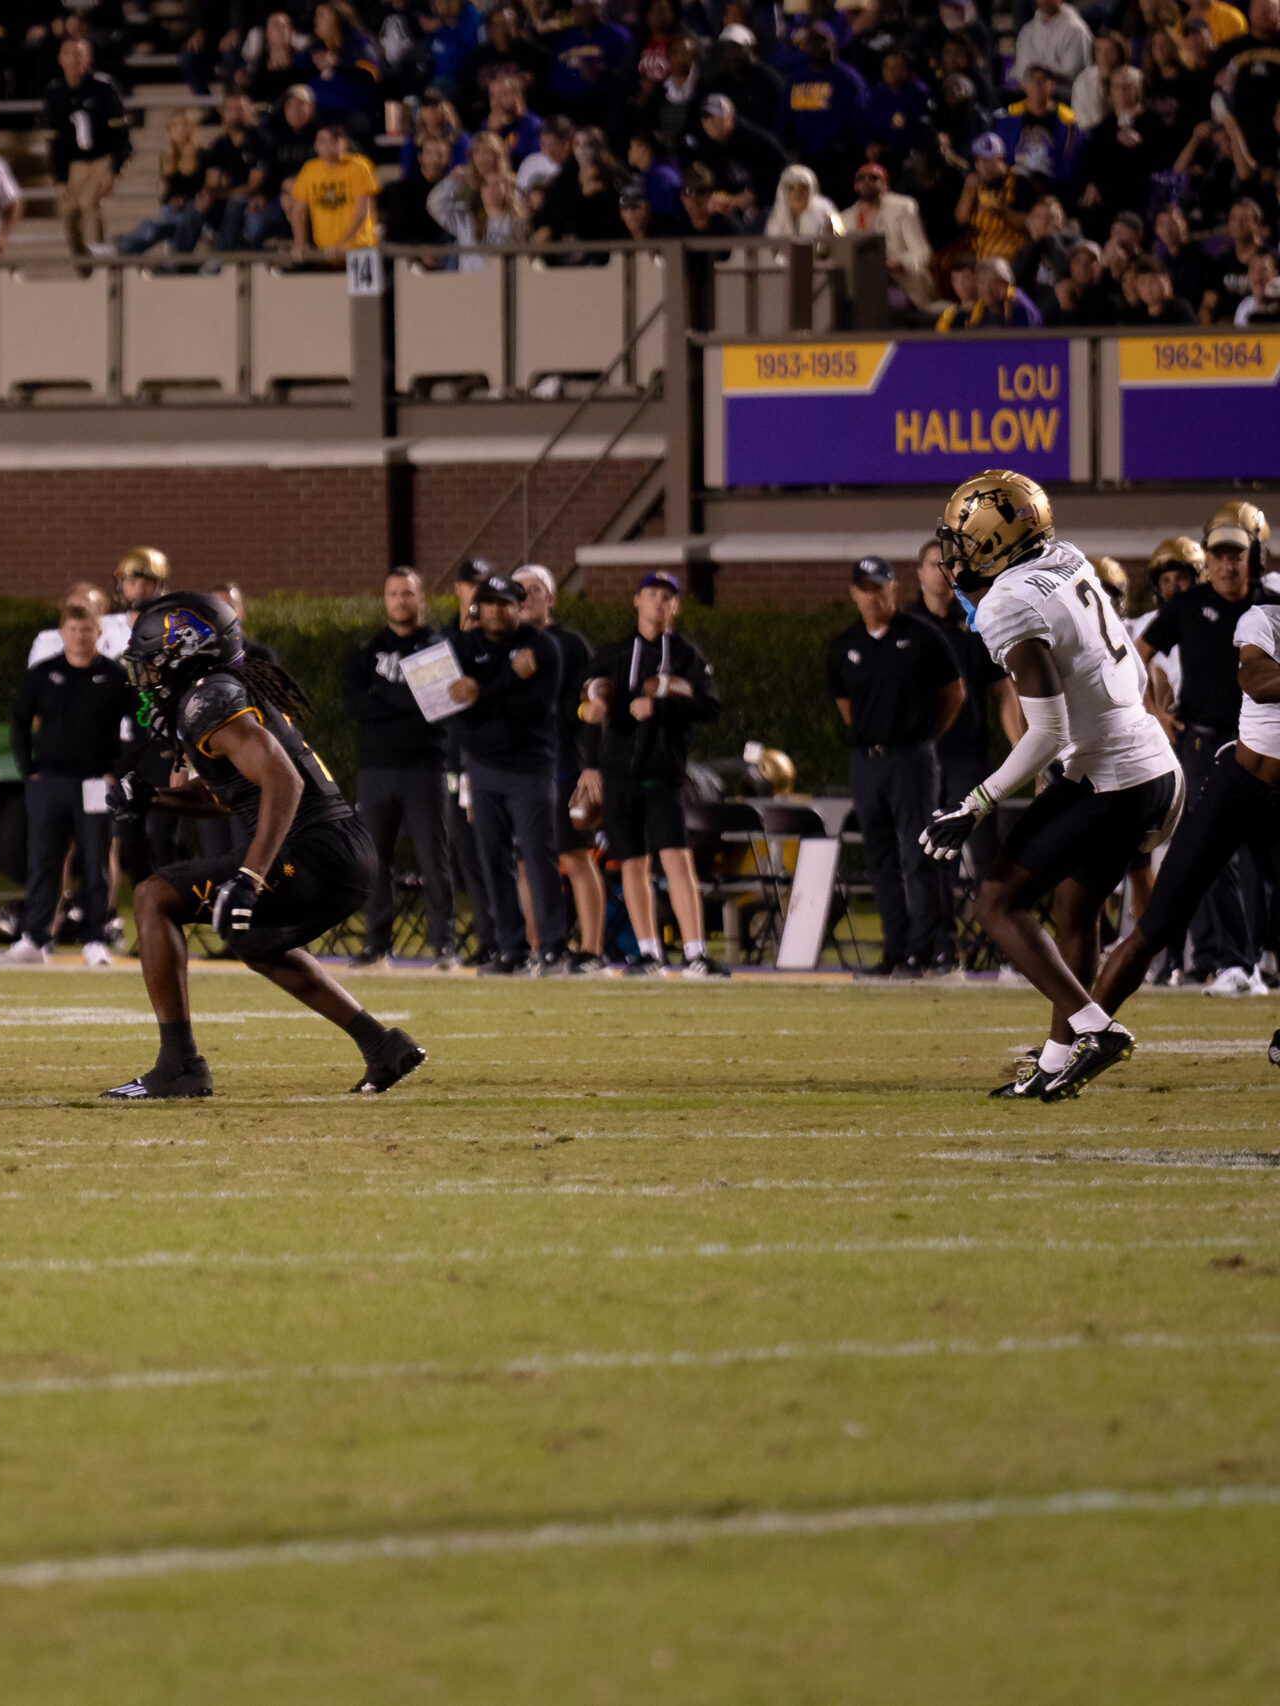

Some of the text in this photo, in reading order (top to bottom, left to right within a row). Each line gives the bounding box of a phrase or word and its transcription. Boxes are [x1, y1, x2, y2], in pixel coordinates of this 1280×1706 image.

[351, 256, 373, 289] 14
[755, 350, 858, 379] 1953-1955
[1153, 342, 1263, 370] 1962-1964
[998, 364, 1061, 401] LOU
[895, 407, 1061, 455] HALLOW
[1075, 578, 1128, 665] 2
